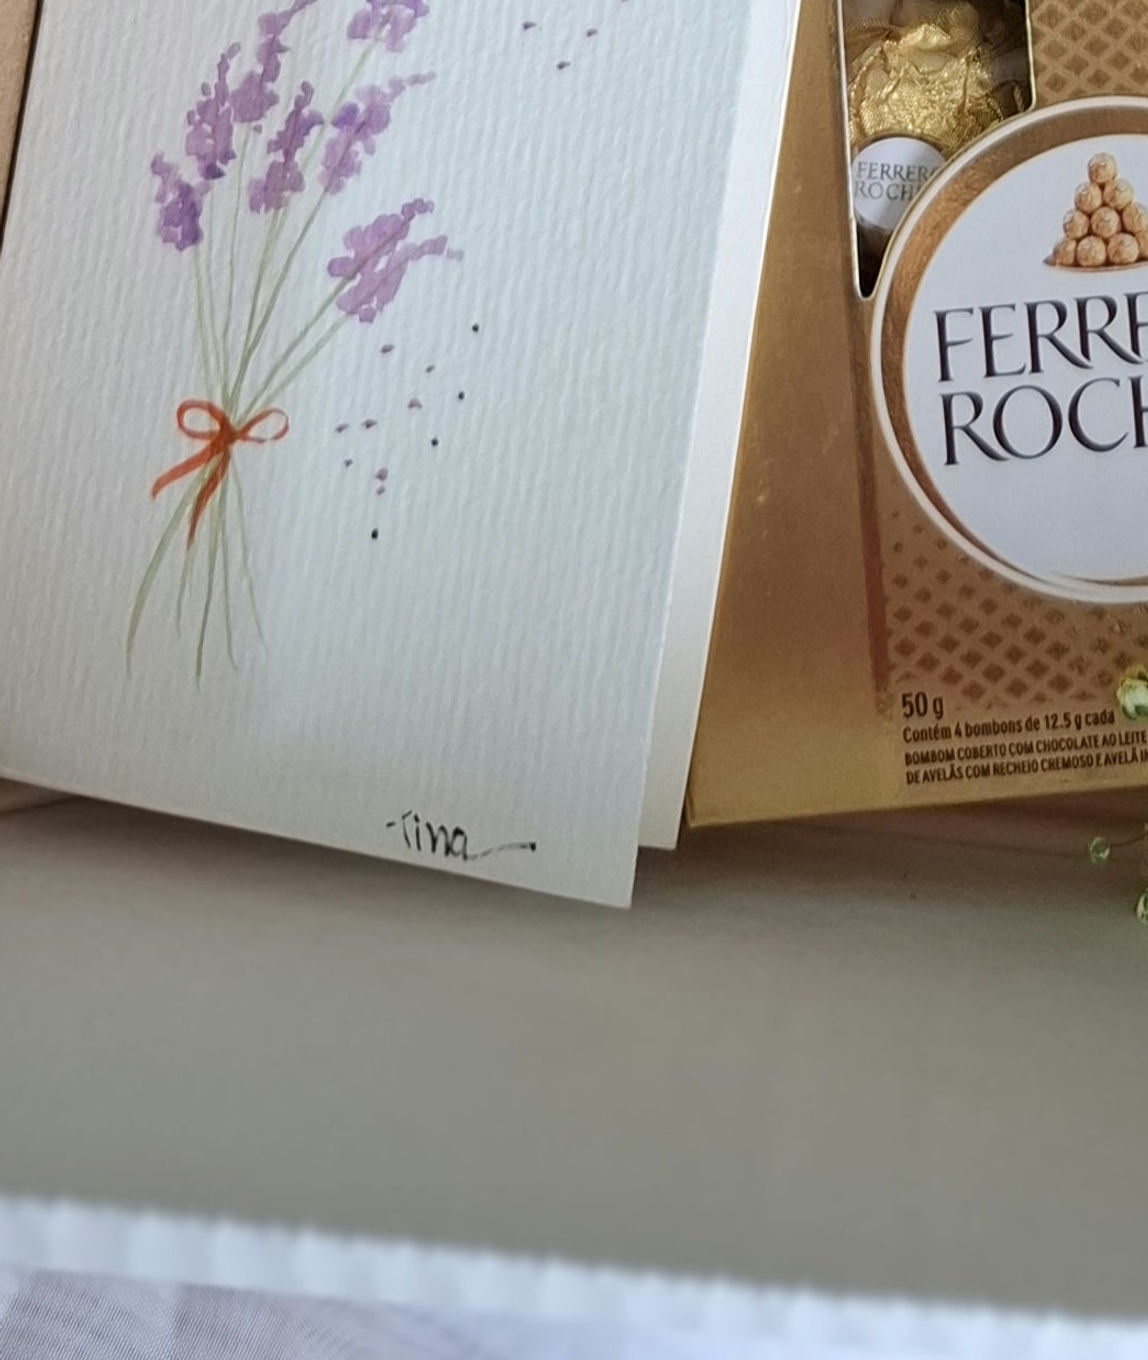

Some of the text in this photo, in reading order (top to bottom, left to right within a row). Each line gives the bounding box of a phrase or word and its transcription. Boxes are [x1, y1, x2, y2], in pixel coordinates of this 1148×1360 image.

[857, 161, 940, 183] FERRER
[854, 181, 924, 202] ROCH
[901, 691, 944, 720] 50 g
[902, 722, 952, 743] Contém
[954, 722, 962, 738] 4
[964, 718, 1022, 738] bombons
[1025, 714, 1040, 732] de
[1074, 713, 1082, 731] g
[1085, 709, 1115, 726] cada
[905, 748, 955, 766] BOMBOM
[957, 742, 1006, 761] COBERTO
[1008, 740, 1034, 756] COM
[1036, 733, 1100, 753] CHOCOLATE
[1102, 732, 1117, 747] AO
[1119, 730, 1147, 746] LEITE
[906, 770, 920, 785] DE
[922, 763, 964, 783] AVELÃS
[965, 762, 991, 780] COM
[993, 759, 1039, 777] RECHEIO
[1041, 754, 1094, 772] CREMOSO
[1096, 753, 1102, 768] E
[1103, 747, 1138, 766] AVELÃ
